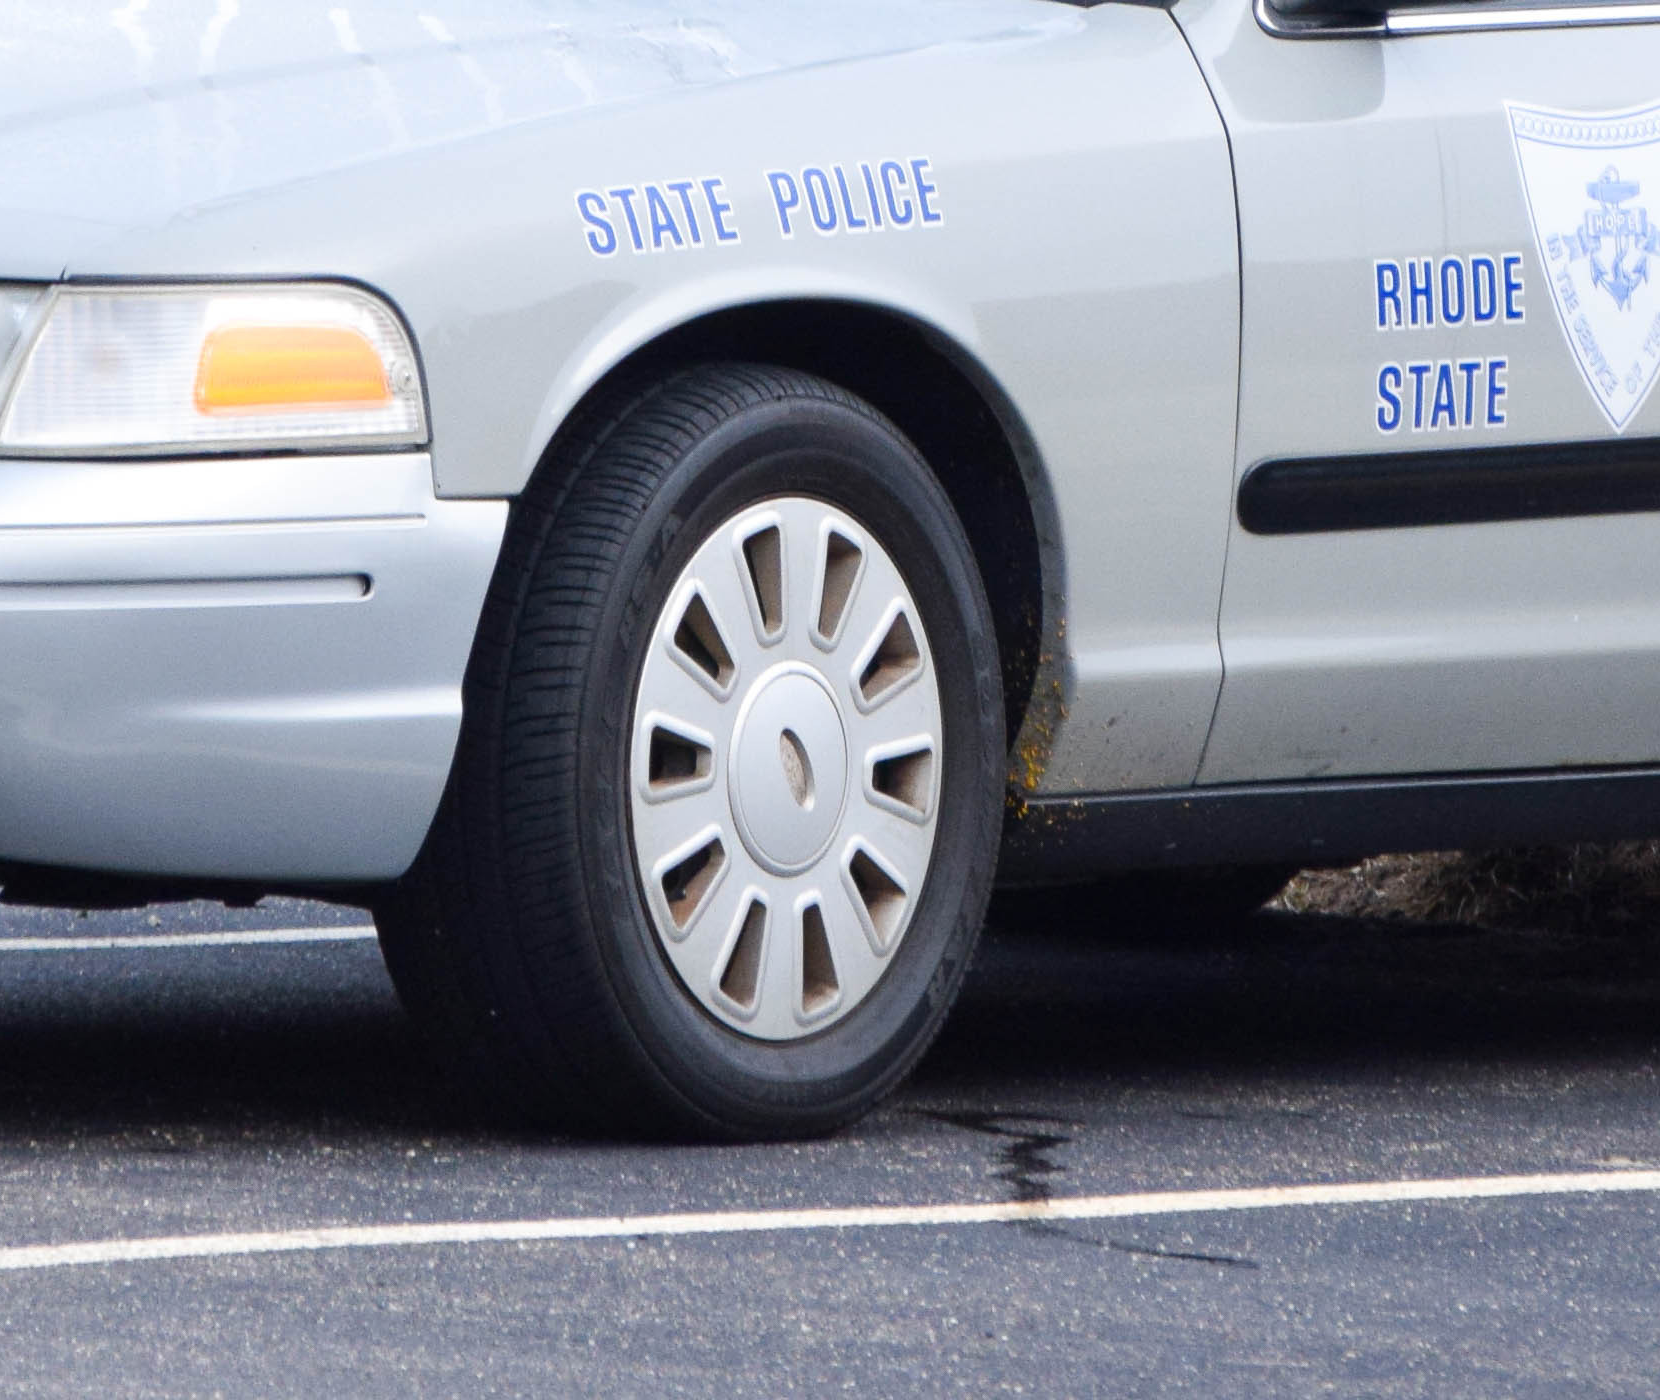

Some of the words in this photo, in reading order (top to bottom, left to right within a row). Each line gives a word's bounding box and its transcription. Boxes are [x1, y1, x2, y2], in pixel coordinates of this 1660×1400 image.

[576, 176, 740, 256] STATE
[764, 156, 943, 236] POLICE
[1375, 255, 1525, 329] RHODE
[1375, 358, 1508, 433] STATE
